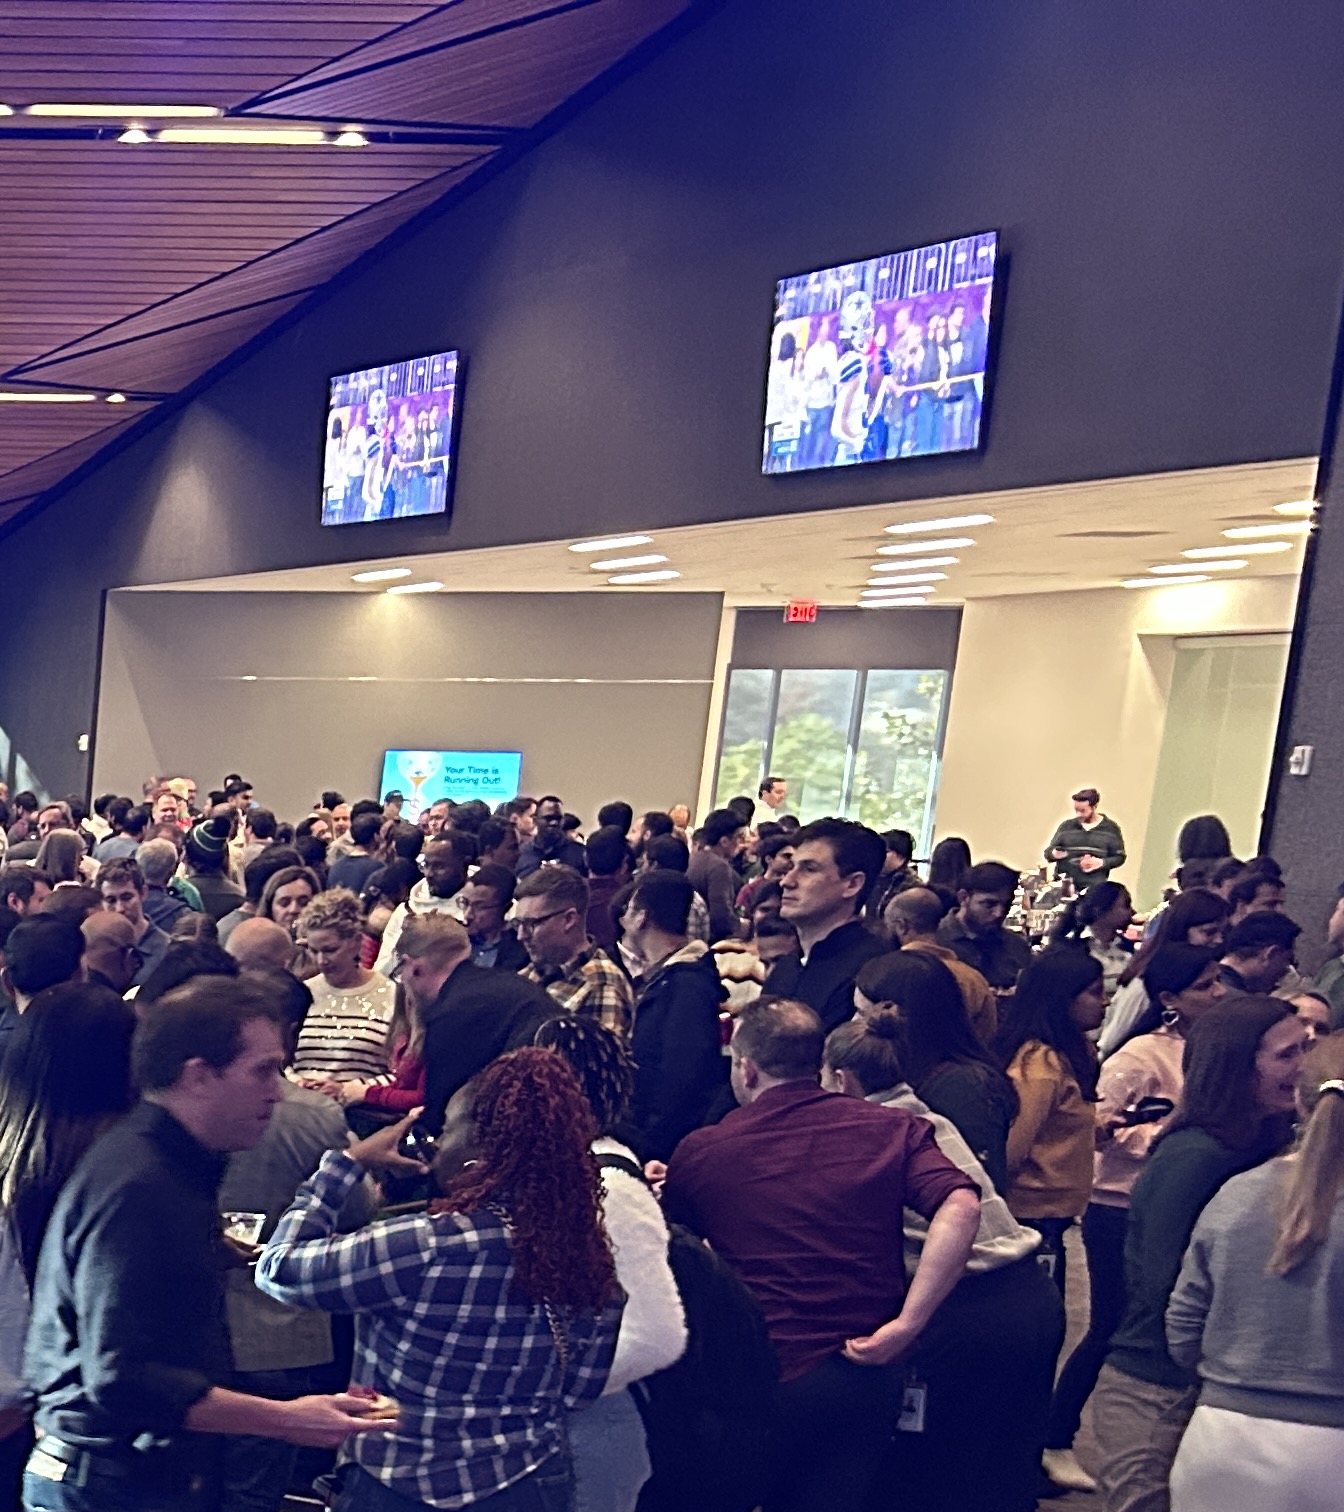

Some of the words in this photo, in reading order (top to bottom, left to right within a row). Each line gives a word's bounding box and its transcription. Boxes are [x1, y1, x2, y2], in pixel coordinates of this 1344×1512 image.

[445, 765, 465, 775] Your
[467, 766, 489, 775] Time
[491, 766, 499, 775] is
[443, 775, 480, 786] Running
